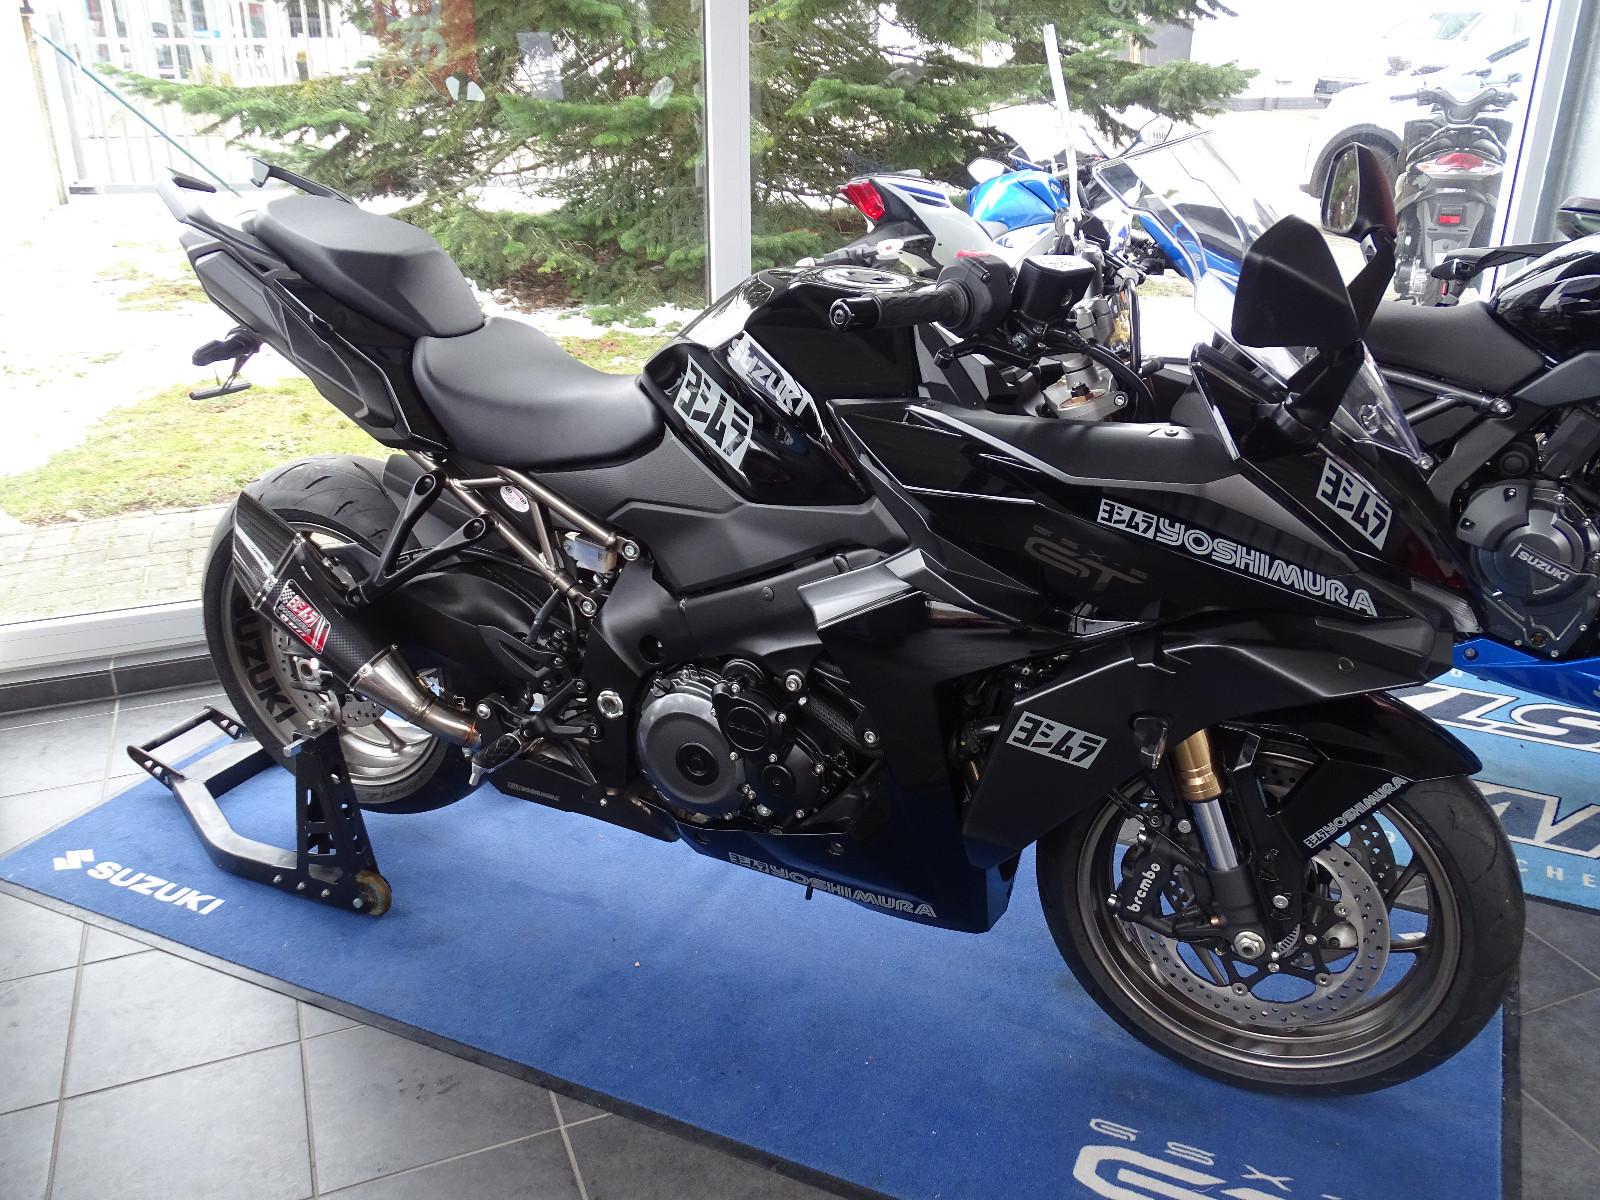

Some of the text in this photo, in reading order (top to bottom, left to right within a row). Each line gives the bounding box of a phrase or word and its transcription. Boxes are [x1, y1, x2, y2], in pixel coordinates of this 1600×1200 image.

[727, 338, 810, 418] SUZUKI
[1156, 517, 1378, 617] YOSHIMURA
[1517, 550, 1570, 582] SUZUKI
[1322, 776, 1408, 834] YOSHIMURA
[87, 861, 226, 915] SUZUKI
[769, 864, 936, 918] YOSHIMURA
[1127, 863, 1160, 912] brembo
